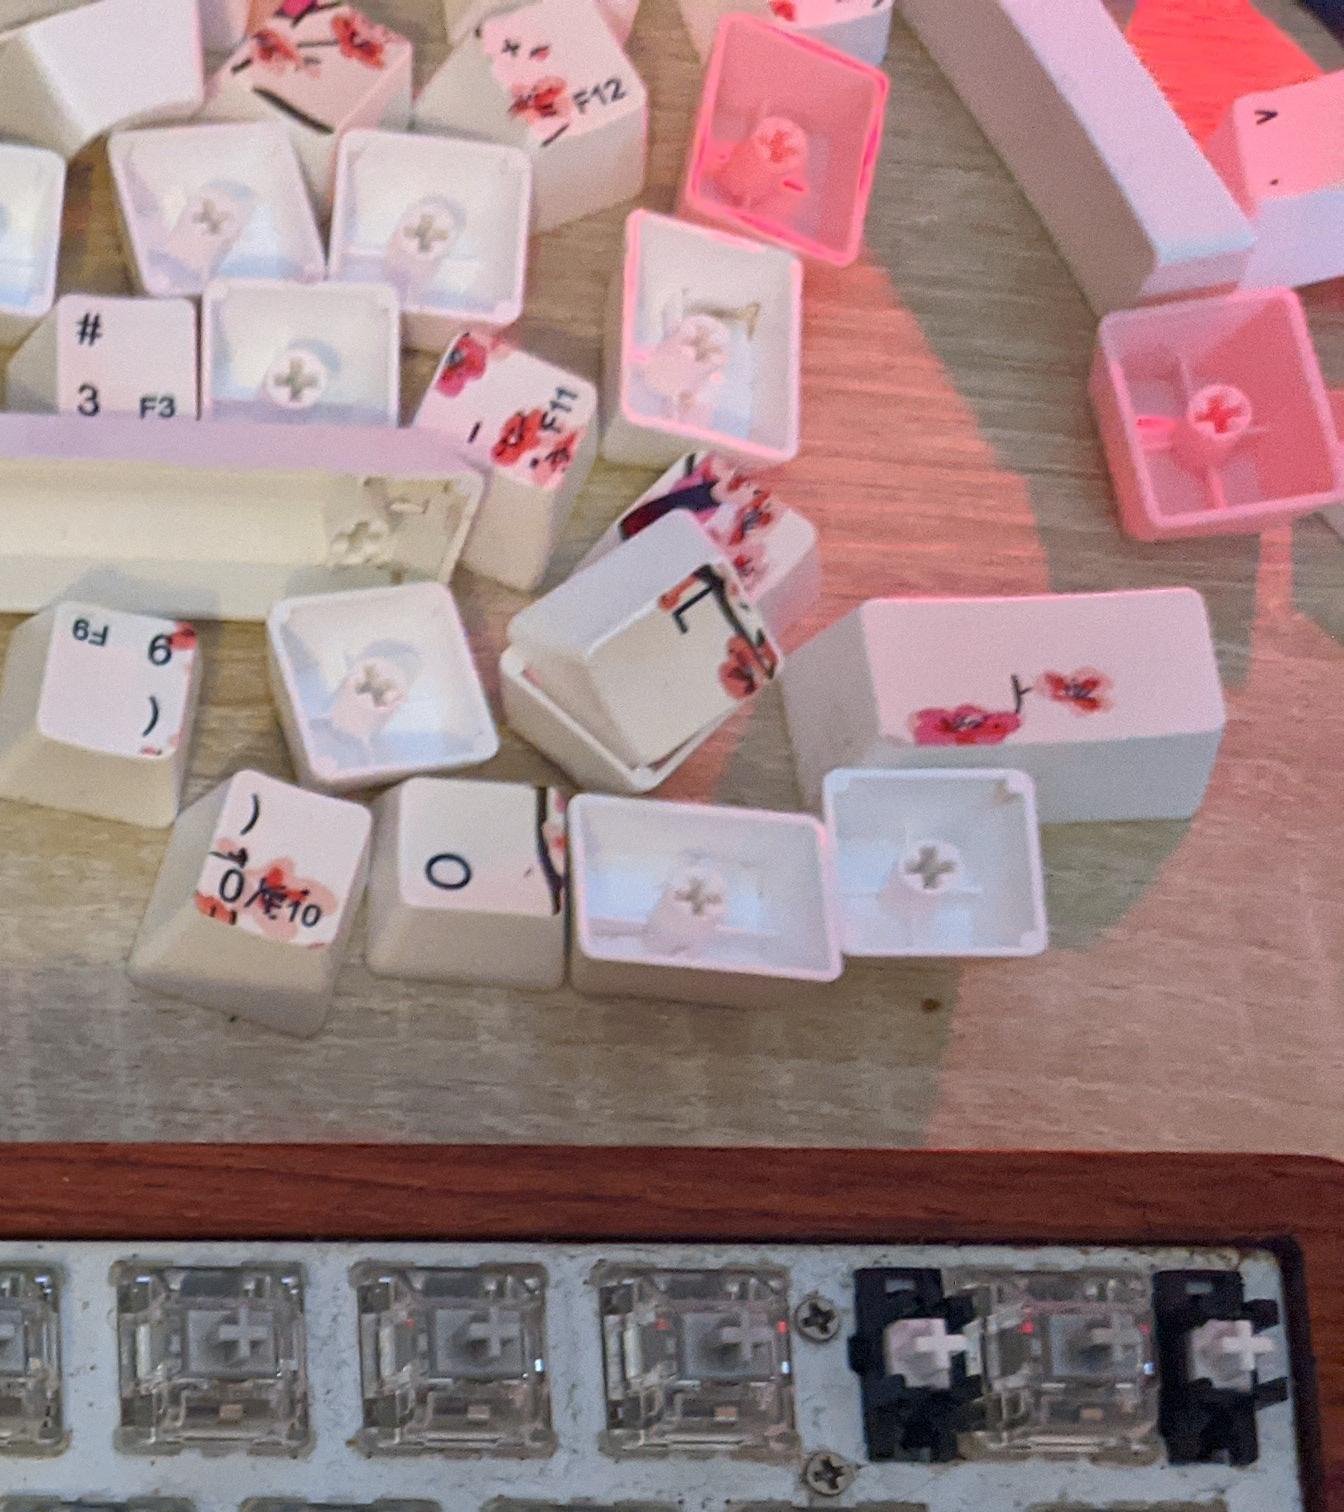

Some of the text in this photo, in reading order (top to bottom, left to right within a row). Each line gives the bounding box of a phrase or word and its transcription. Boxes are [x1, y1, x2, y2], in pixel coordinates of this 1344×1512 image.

[572, 77, 627, 114] F12
[1254, 109, 1279, 125] >
[76, 312, 103, 346] #
[77, 382, 176, 420] 3 F3
[540, 386, 579, 434] F11
[71, 617, 109, 647] F9
[239, 793, 261, 836] )
